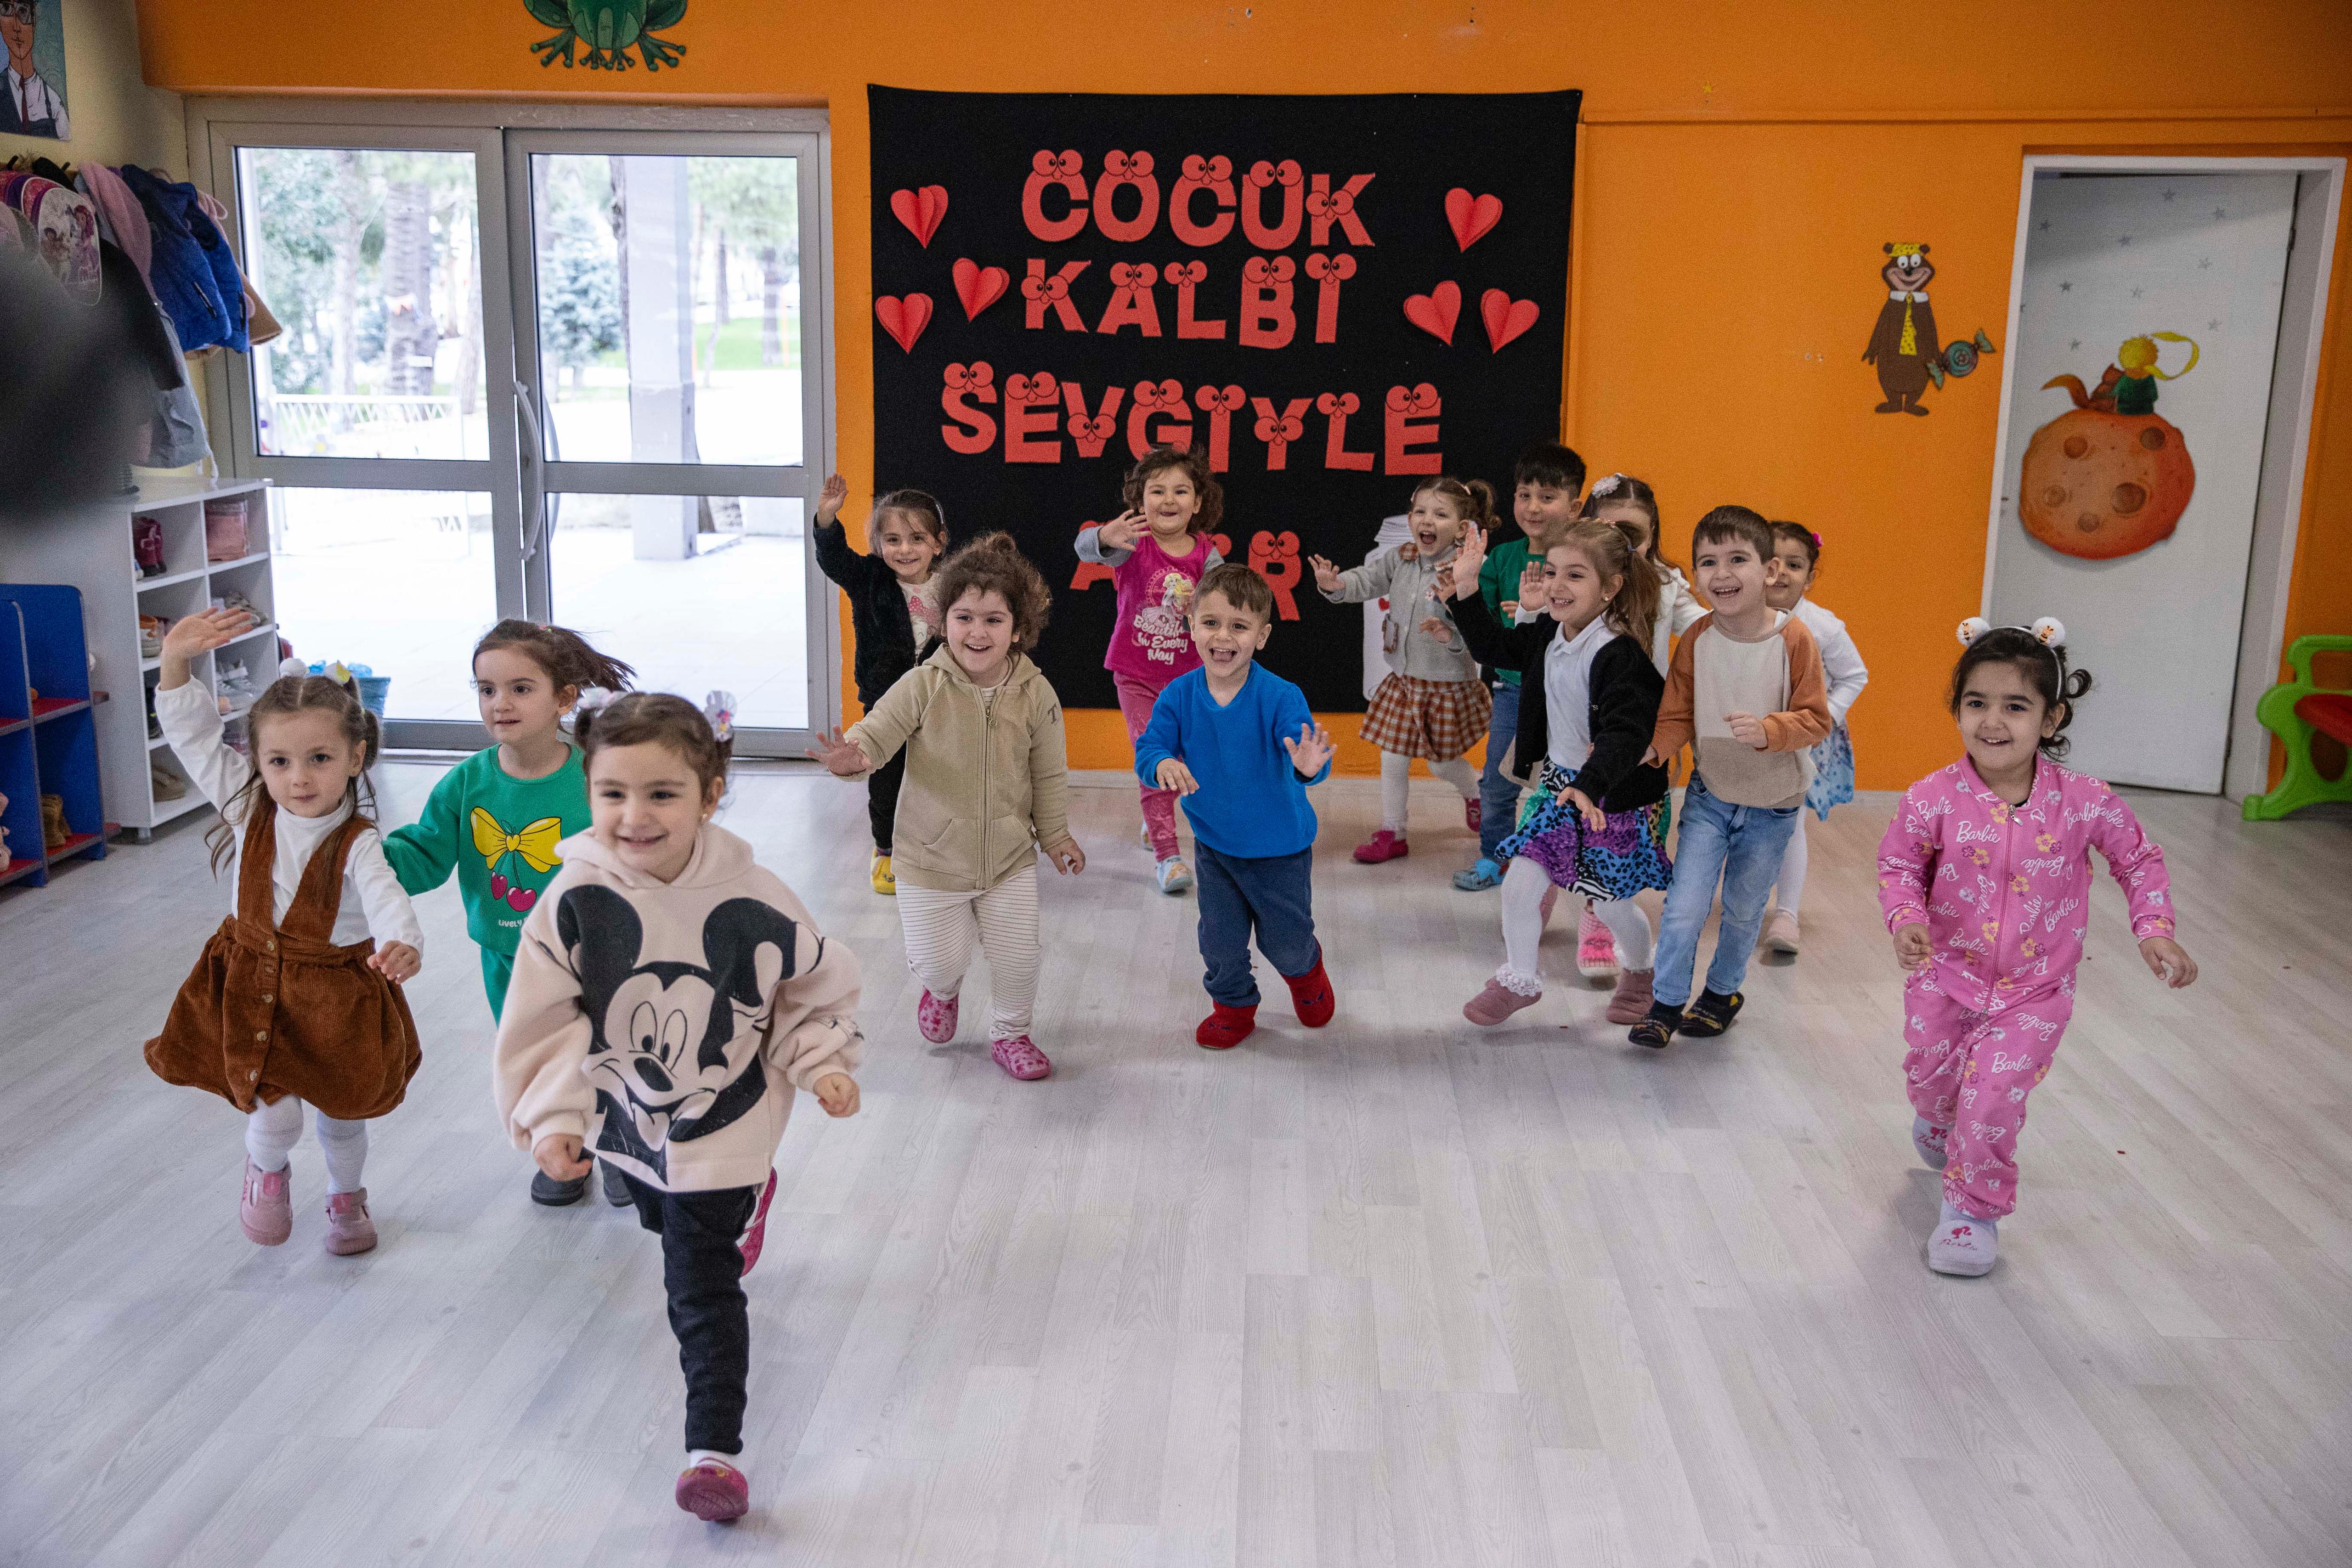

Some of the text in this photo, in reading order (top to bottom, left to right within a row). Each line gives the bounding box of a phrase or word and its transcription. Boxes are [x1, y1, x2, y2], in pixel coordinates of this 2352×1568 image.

[1915, 796, 1955, 822] Barbie
[1956, 821, 2000, 843] Barbie
[2020, 855, 2064, 876] Barbie
[2044, 897, 2079, 933] Barbie
[1949, 928, 1989, 955] Barbie
[2015, 1012, 2057, 1042] Barbie
[1991, 1052, 2034, 1074] Barbie
